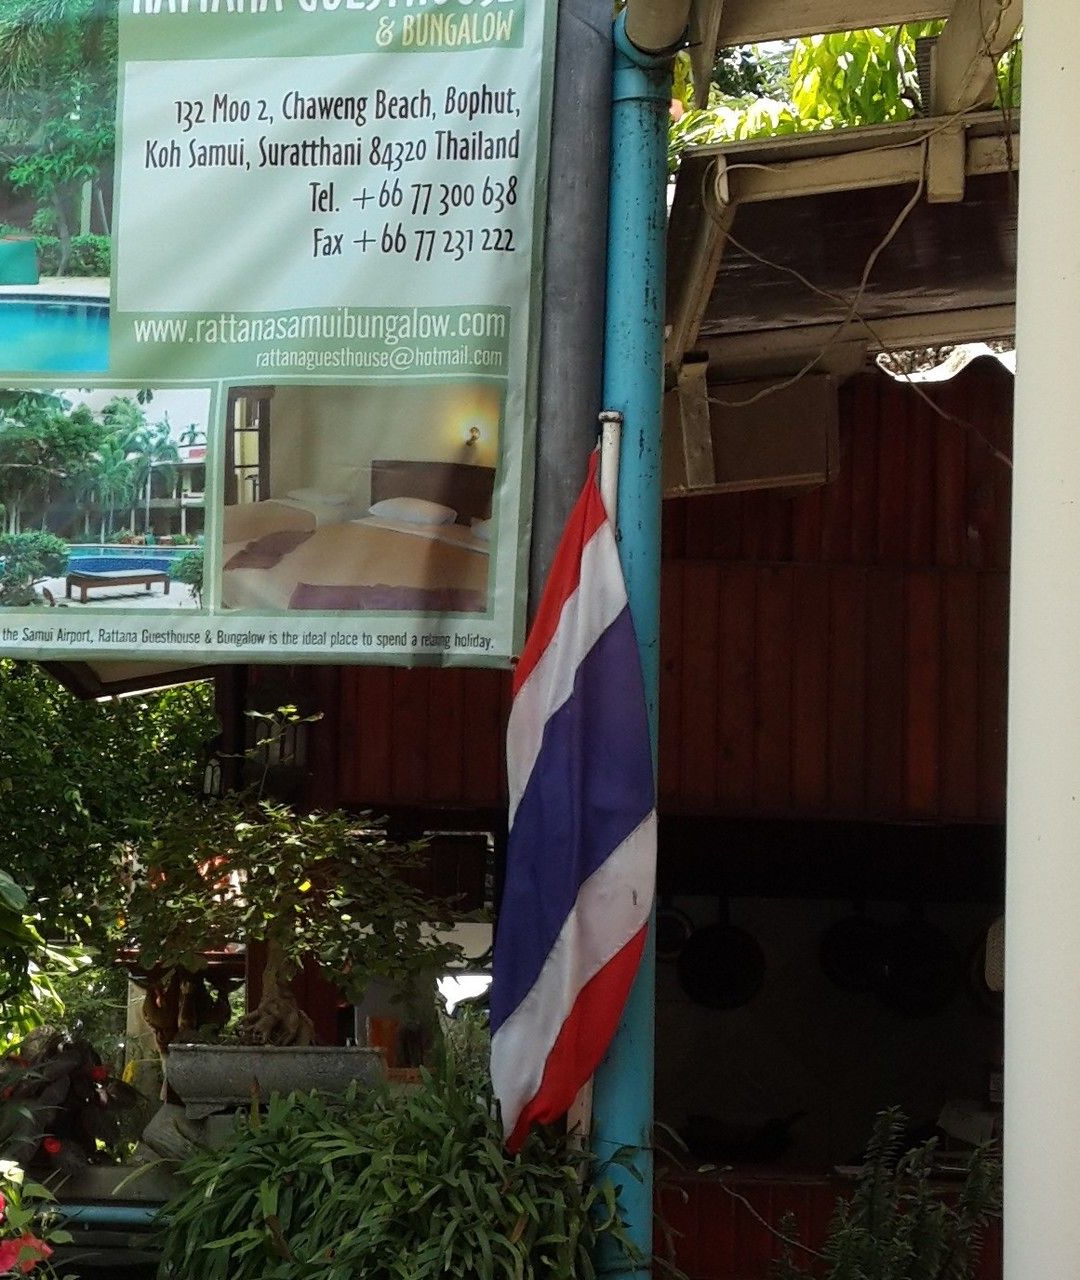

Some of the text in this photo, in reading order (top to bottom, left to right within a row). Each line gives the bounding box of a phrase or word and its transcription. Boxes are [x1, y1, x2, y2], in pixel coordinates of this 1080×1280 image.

[376, 9, 515, 47] & BUNGALOW
[174, 84, 521, 132] 132 Moo 2, Chaweng Beach, Bophut,
[145, 129, 520, 171] Koh Samui, Suratthani 84320 Thailand
[309, 181, 341, 213] Tel.
[410, 182, 433, 216] 77
[439, 182, 475, 216] 300
[481, 175, 518, 214] 638
[313, 228, 342, 257] Fax
[414, 230, 437, 262] 77
[442, 227, 473, 261] 231
[481, 227, 516, 252] 222
[133, 307, 506, 345] www.rattanasamuibungalow.com
[255, 346, 503, 370] rattanaguesthouse@hotmail.com
[2, 628, 19, 641] the
[22, 628, 54, 642] Samui
[57, 628, 94, 644] Airport,
[98, 629, 137, 643] Rattana
[141, 629, 200, 644] Guesthouse
[205, 630, 212, 644] &
[217, 630, 265, 647] Bungalow
[269, 630, 277, 644] is
[282, 631, 298, 645] the
[302, 631, 327, 645] ideal
[330, 631, 358, 648] place
[362, 632, 372, 646] to
[376, 632, 407, 648] spend
[411, 634, 417, 646] a
[454, 633, 494, 650] holiday.
